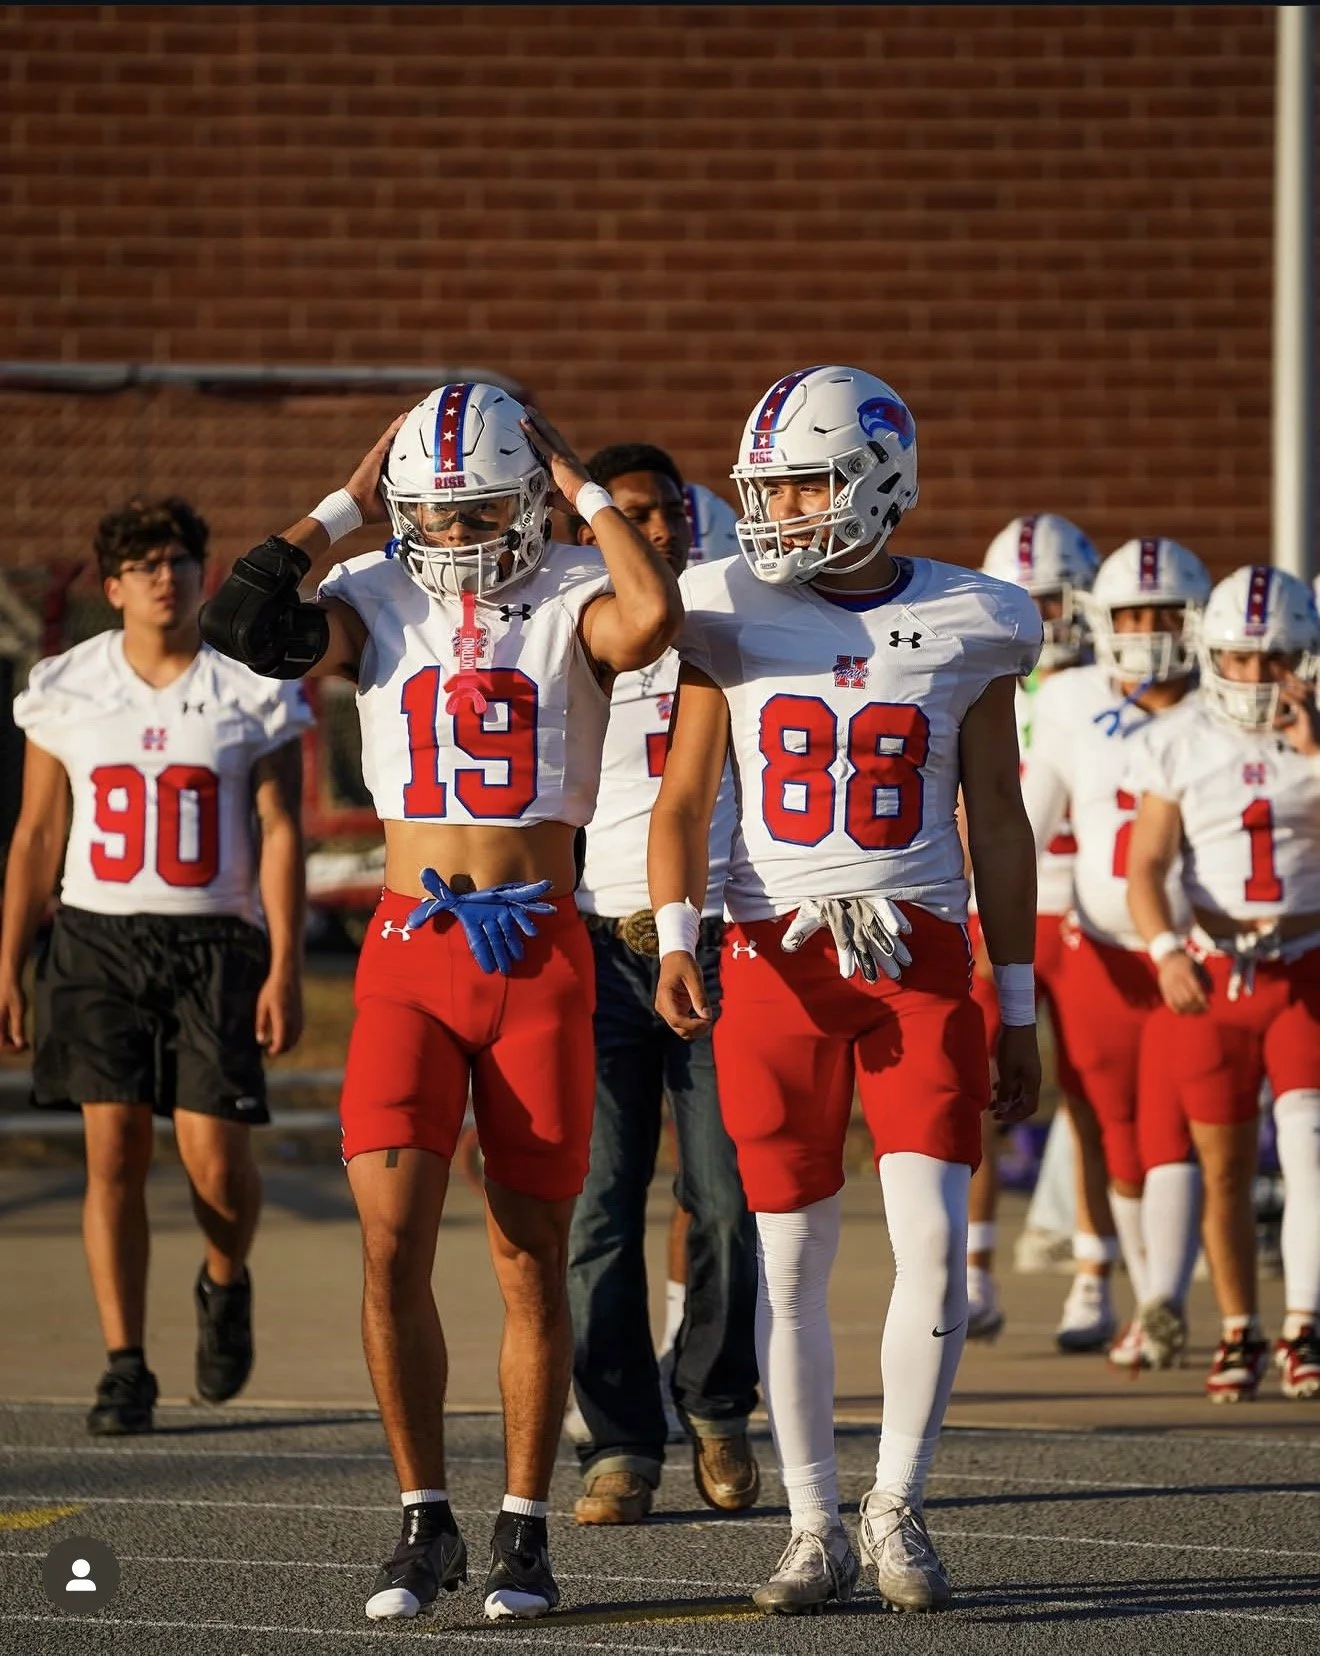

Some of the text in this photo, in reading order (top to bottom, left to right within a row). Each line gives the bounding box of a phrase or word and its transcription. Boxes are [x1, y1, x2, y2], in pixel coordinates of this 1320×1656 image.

[434, 475, 466, 489] RISE
[750, 451, 773, 464] RISE
[400, 665, 539, 819] 19
[758, 693, 931, 851] 88
[89, 763, 220, 887] 90
[1242, 798, 1283, 902] 1
